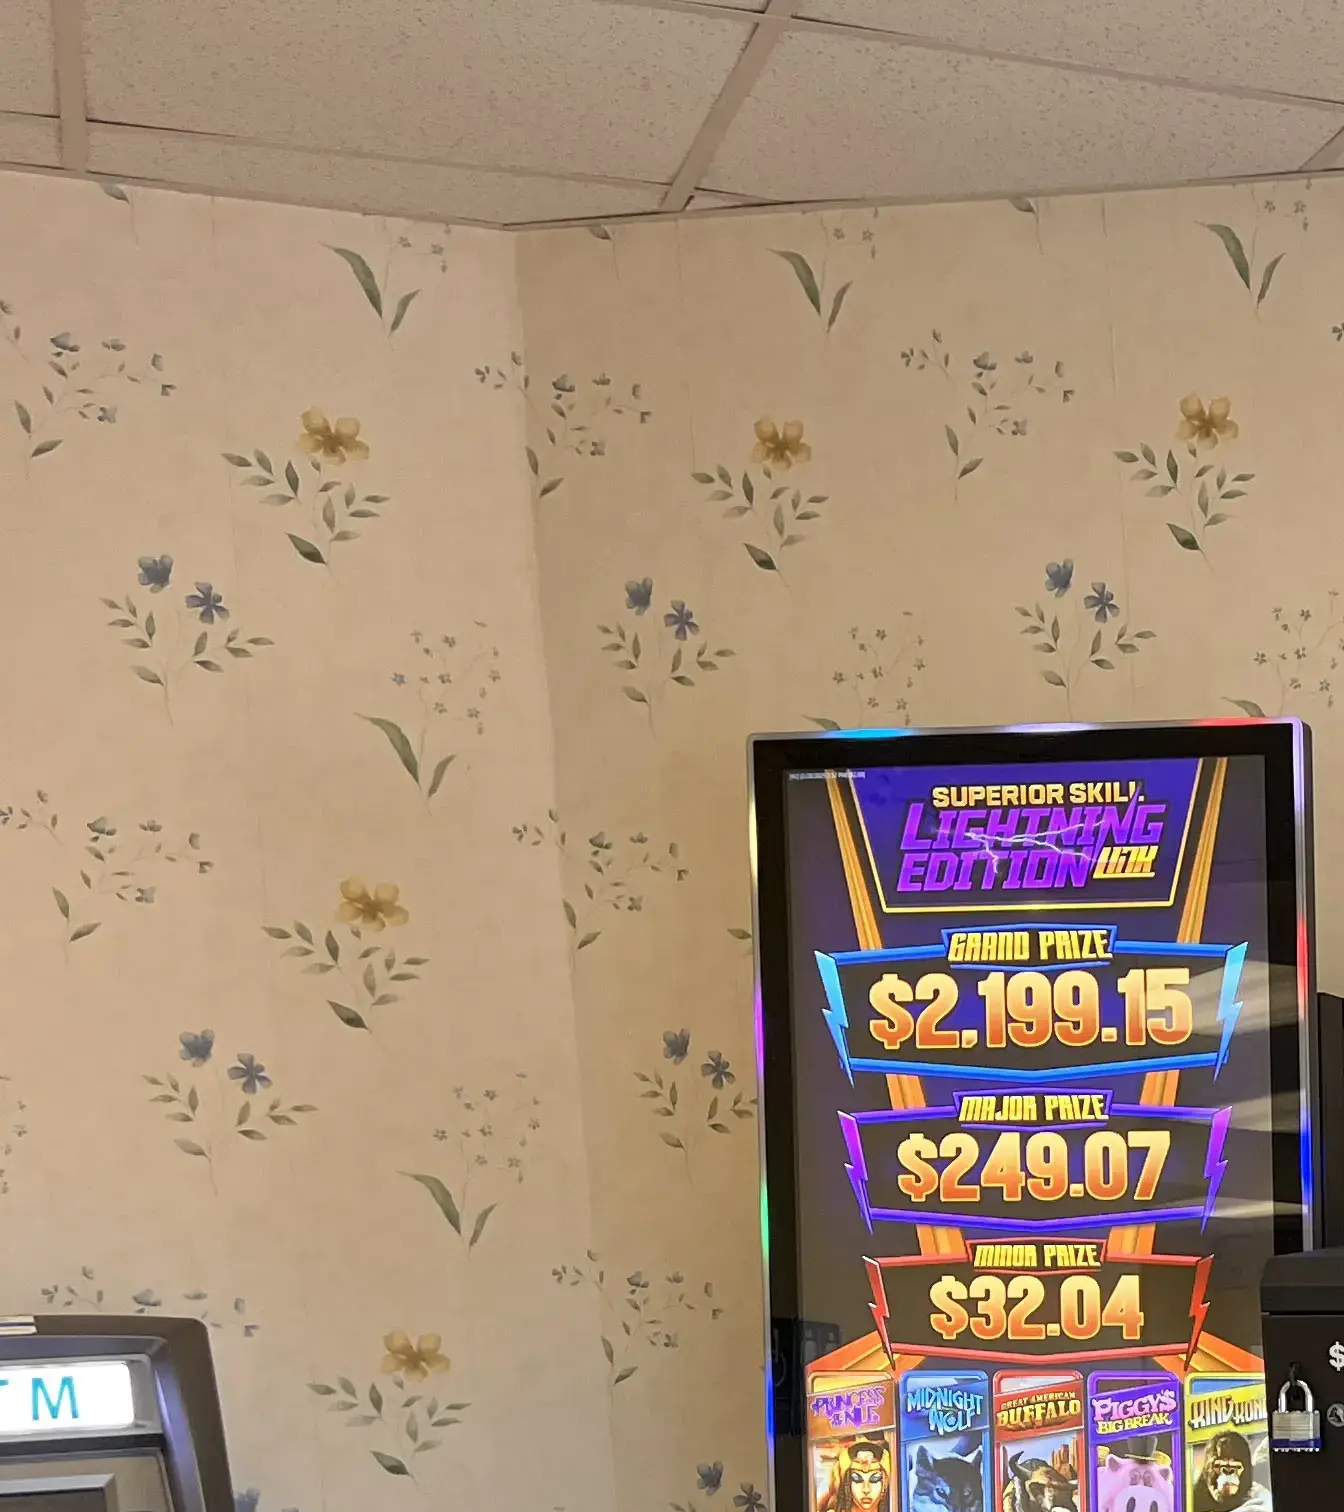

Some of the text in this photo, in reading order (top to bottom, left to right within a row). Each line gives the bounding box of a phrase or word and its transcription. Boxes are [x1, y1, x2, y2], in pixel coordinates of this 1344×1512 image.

[932, 781, 1145, 808] SUPERIOR SKILL
[900, 803, 1167, 850] LIGHTNING
[896, 850, 1094, 892] EDITION
[948, 928, 1114, 962] GRAND PRIZE
[868, 967, 1193, 1050] $2,199.15
[958, 1093, 1110, 1122] MAJOR PRIZE
[896, 1130, 1171, 1203] $249.07
[973, 1243, 1101, 1268] MINOR PRIZE
[929, 1274, 1145, 1340] $32.04
[0, 1375, 79, 1421] M
[907, 1387, 984, 1416] MIDNIGHT
[996, 1399, 1082, 1427] BUFFALO
[1000, 1391, 1077, 1410] GREAT AMERICAN
[928, 1406, 976, 1436] WOLF
[1096, 1412, 1173, 1435] BIG BREAK
